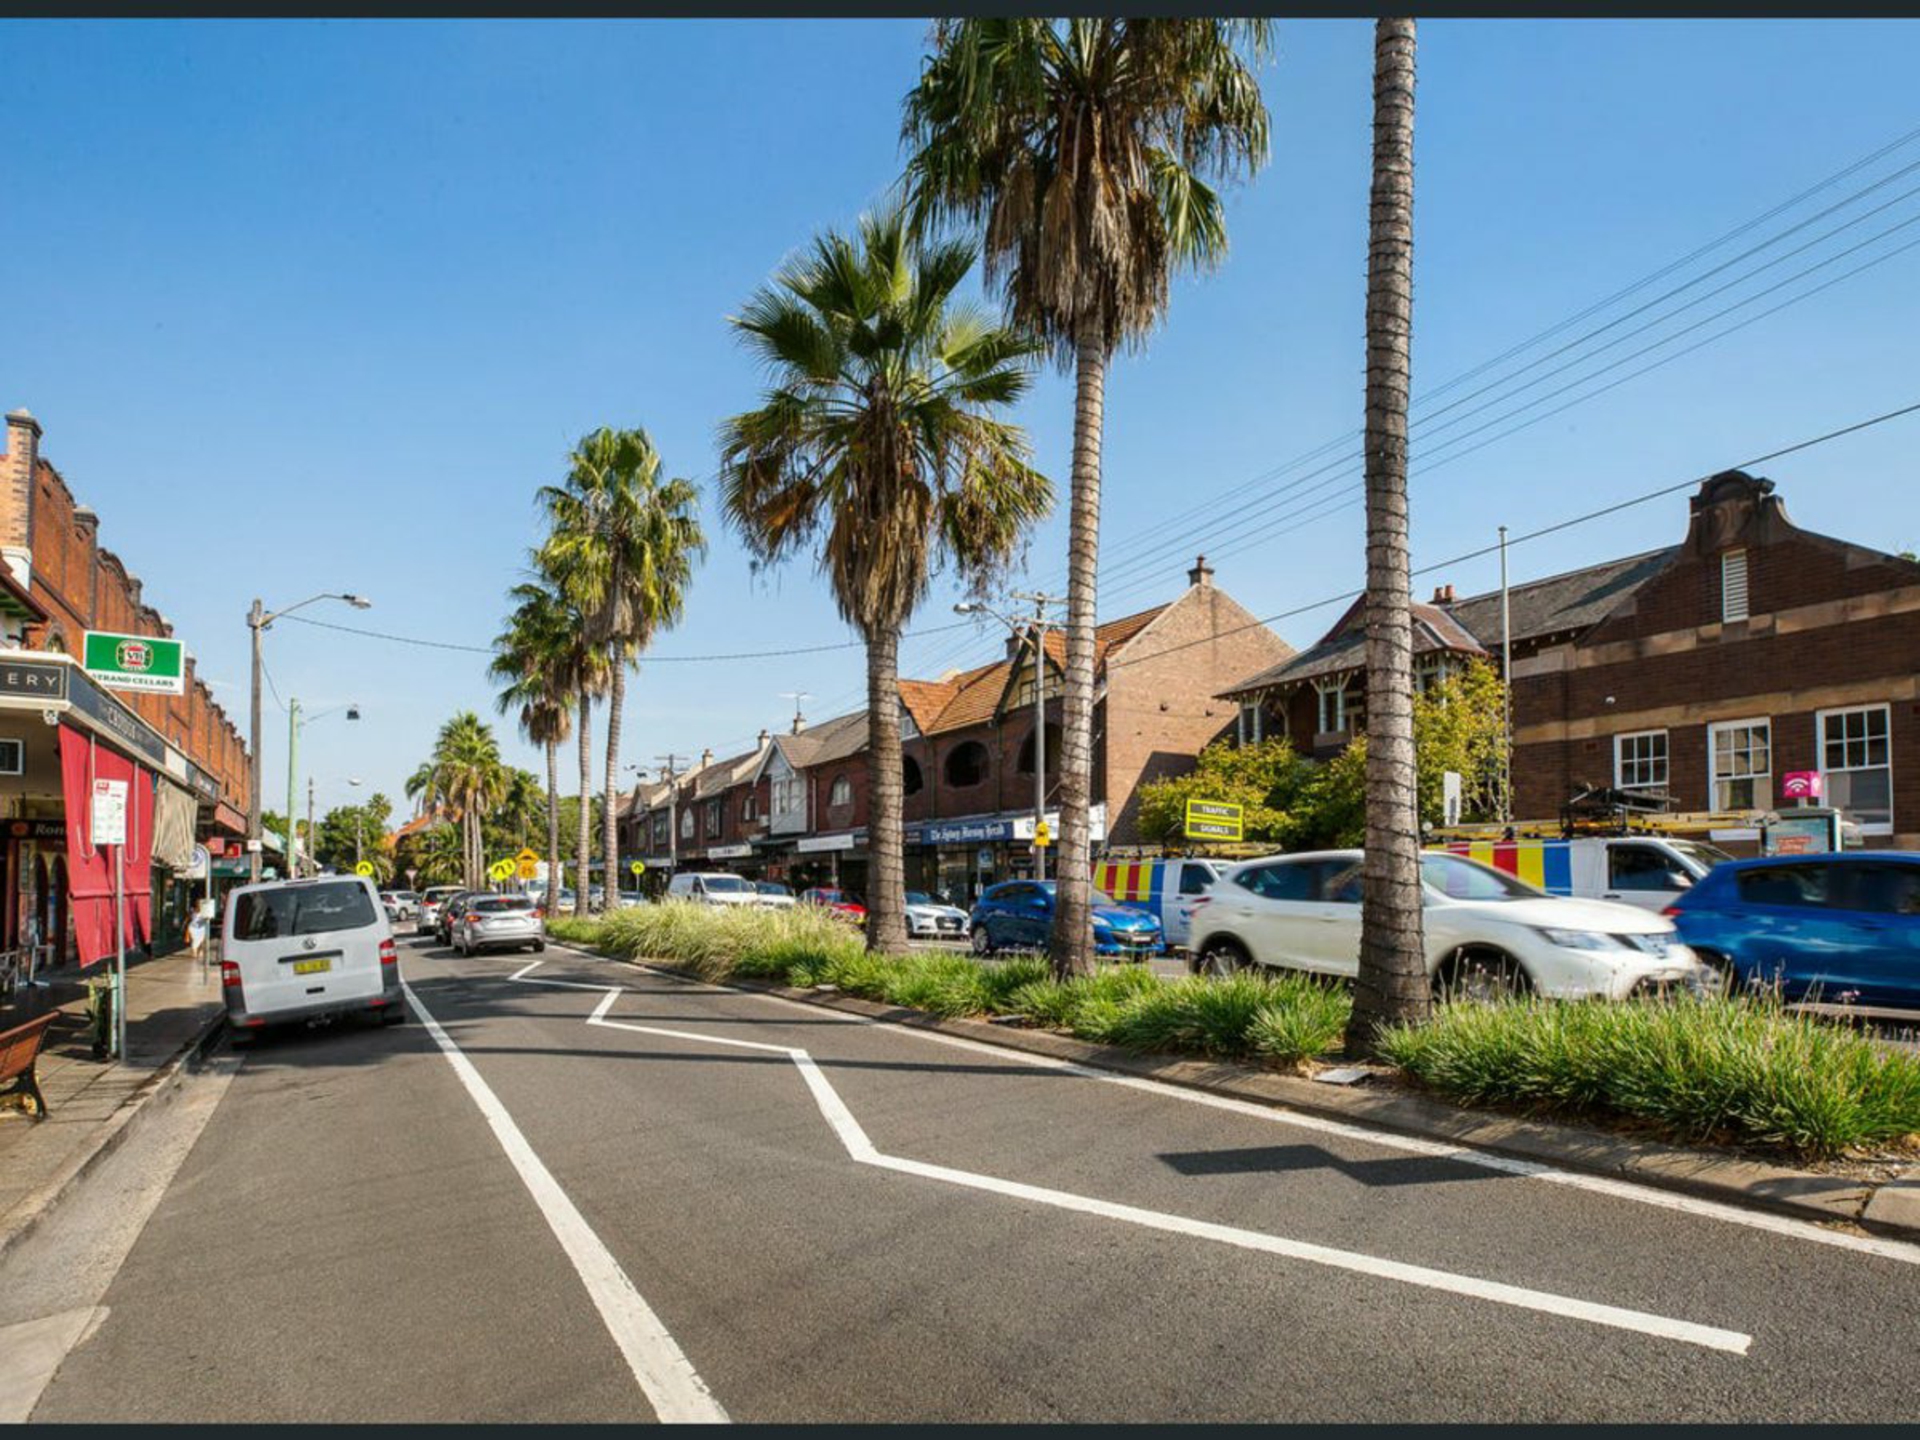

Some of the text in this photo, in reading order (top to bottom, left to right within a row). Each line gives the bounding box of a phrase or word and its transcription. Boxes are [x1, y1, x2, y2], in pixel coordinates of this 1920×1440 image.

[7, 672, 57, 687] ERY
[132, 677, 175, 687] CELLARS
[1202, 805, 1229, 815] TRAFFIC
[1200, 823, 1229, 834] SIGNALS
